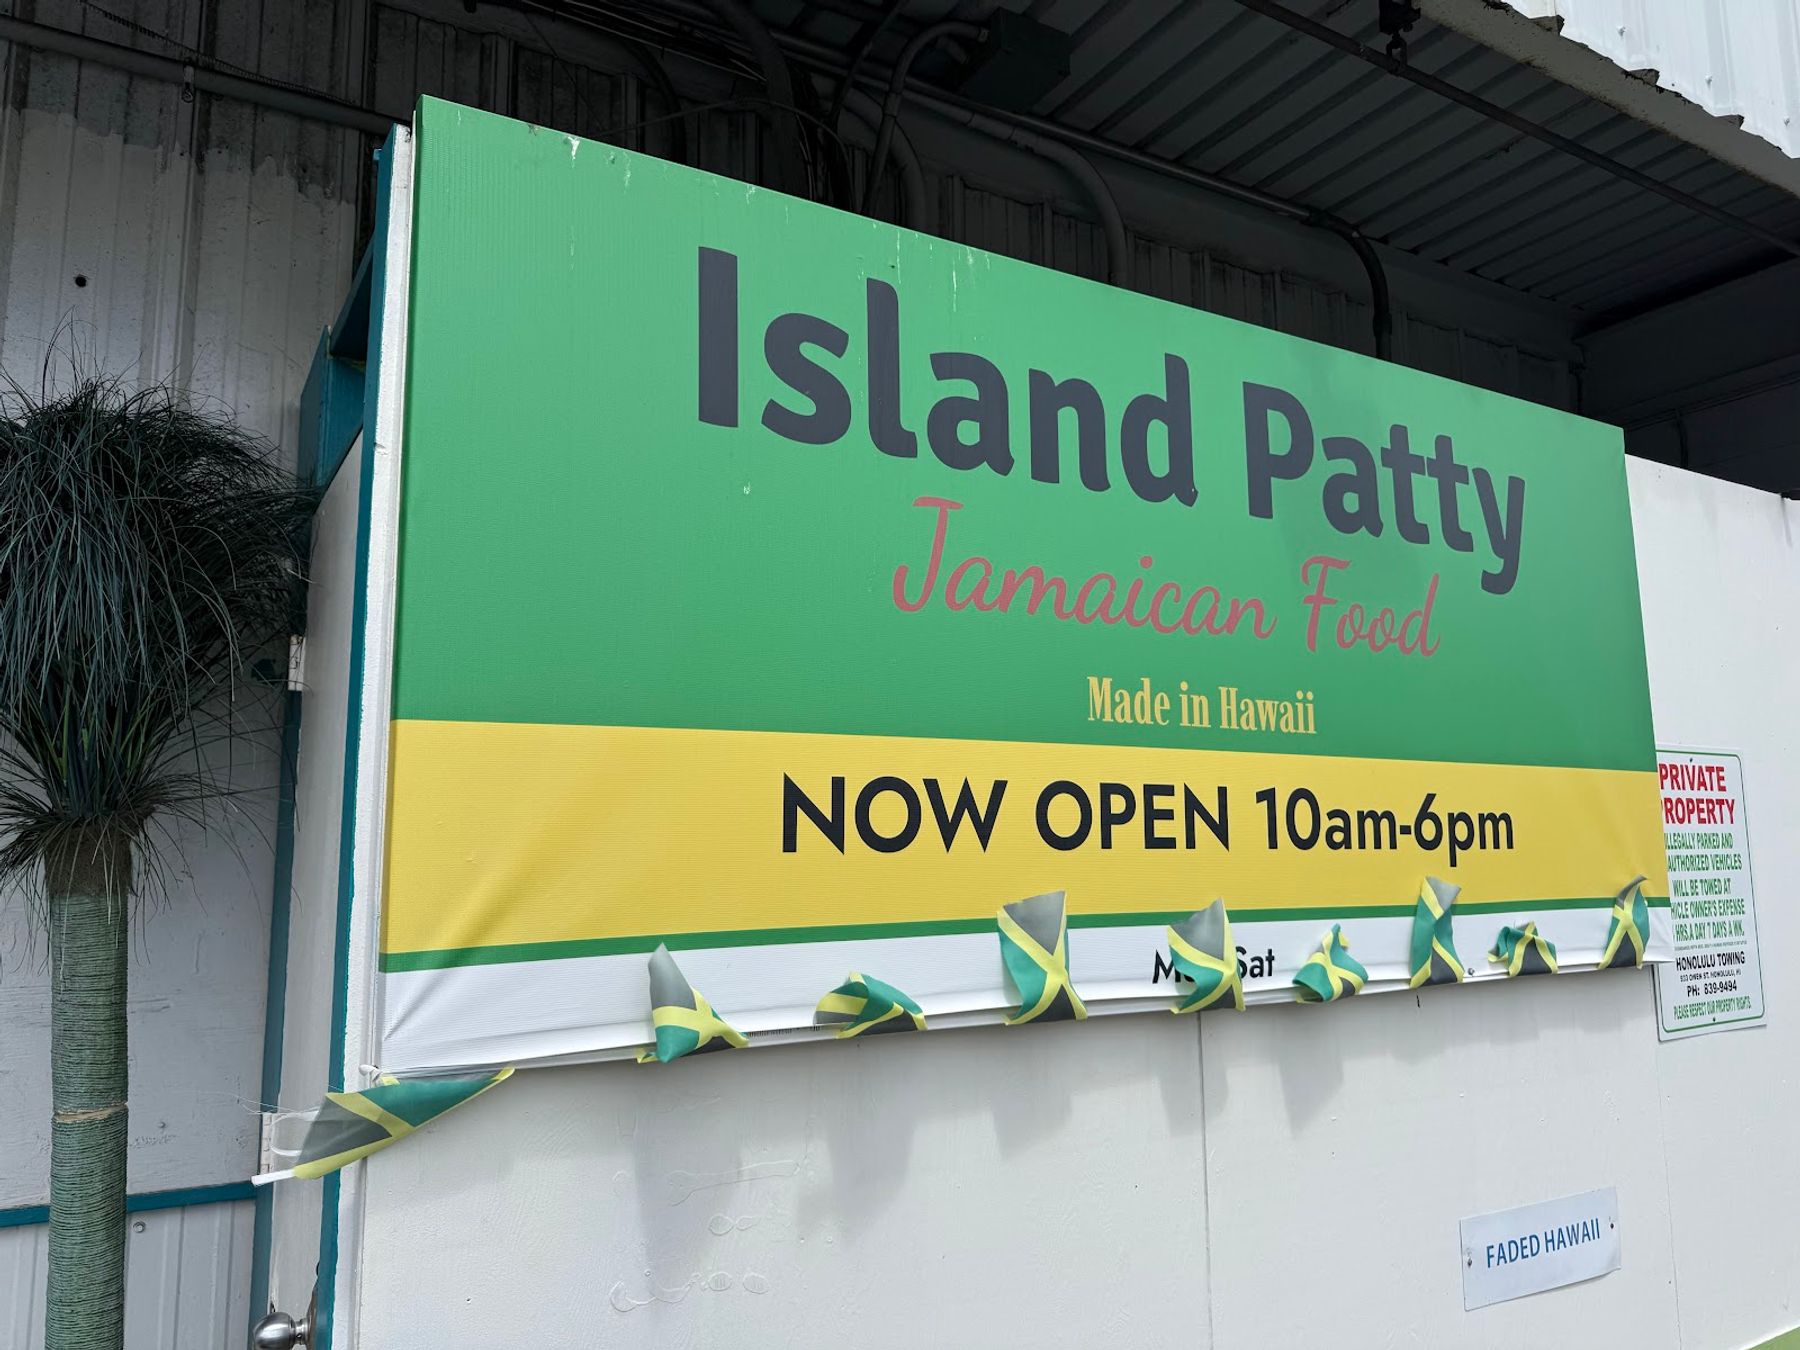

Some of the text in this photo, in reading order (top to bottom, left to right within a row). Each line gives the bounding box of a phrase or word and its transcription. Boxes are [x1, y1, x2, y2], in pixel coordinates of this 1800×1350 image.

[697, 245, 1526, 595] Island Patty
[892, 496, 1441, 657] Jamaican Food
[1087, 676, 1317, 734] Made in Hawaii
[1659, 763, 1727, 791] PRIVATE
[782, 772, 1514, 868] NOW OPEN 10am-6pm
[1661, 797, 1735, 824] ROPERTY
[1697, 833, 1720, 850] PARKED
[1721, 832, 1734, 849] AND
[1710, 853, 1743, 871] VEHICLES
[1672, 878, 1732, 897] WILL BE TOWED AT
[1719, 899, 1745, 917] EXPENSE
[1676, 951, 1745, 971] HONOLULU TOWING
[1687, 984, 1700, 997] PH:
[1486, 1217, 1600, 1268] FADED HAWAII
